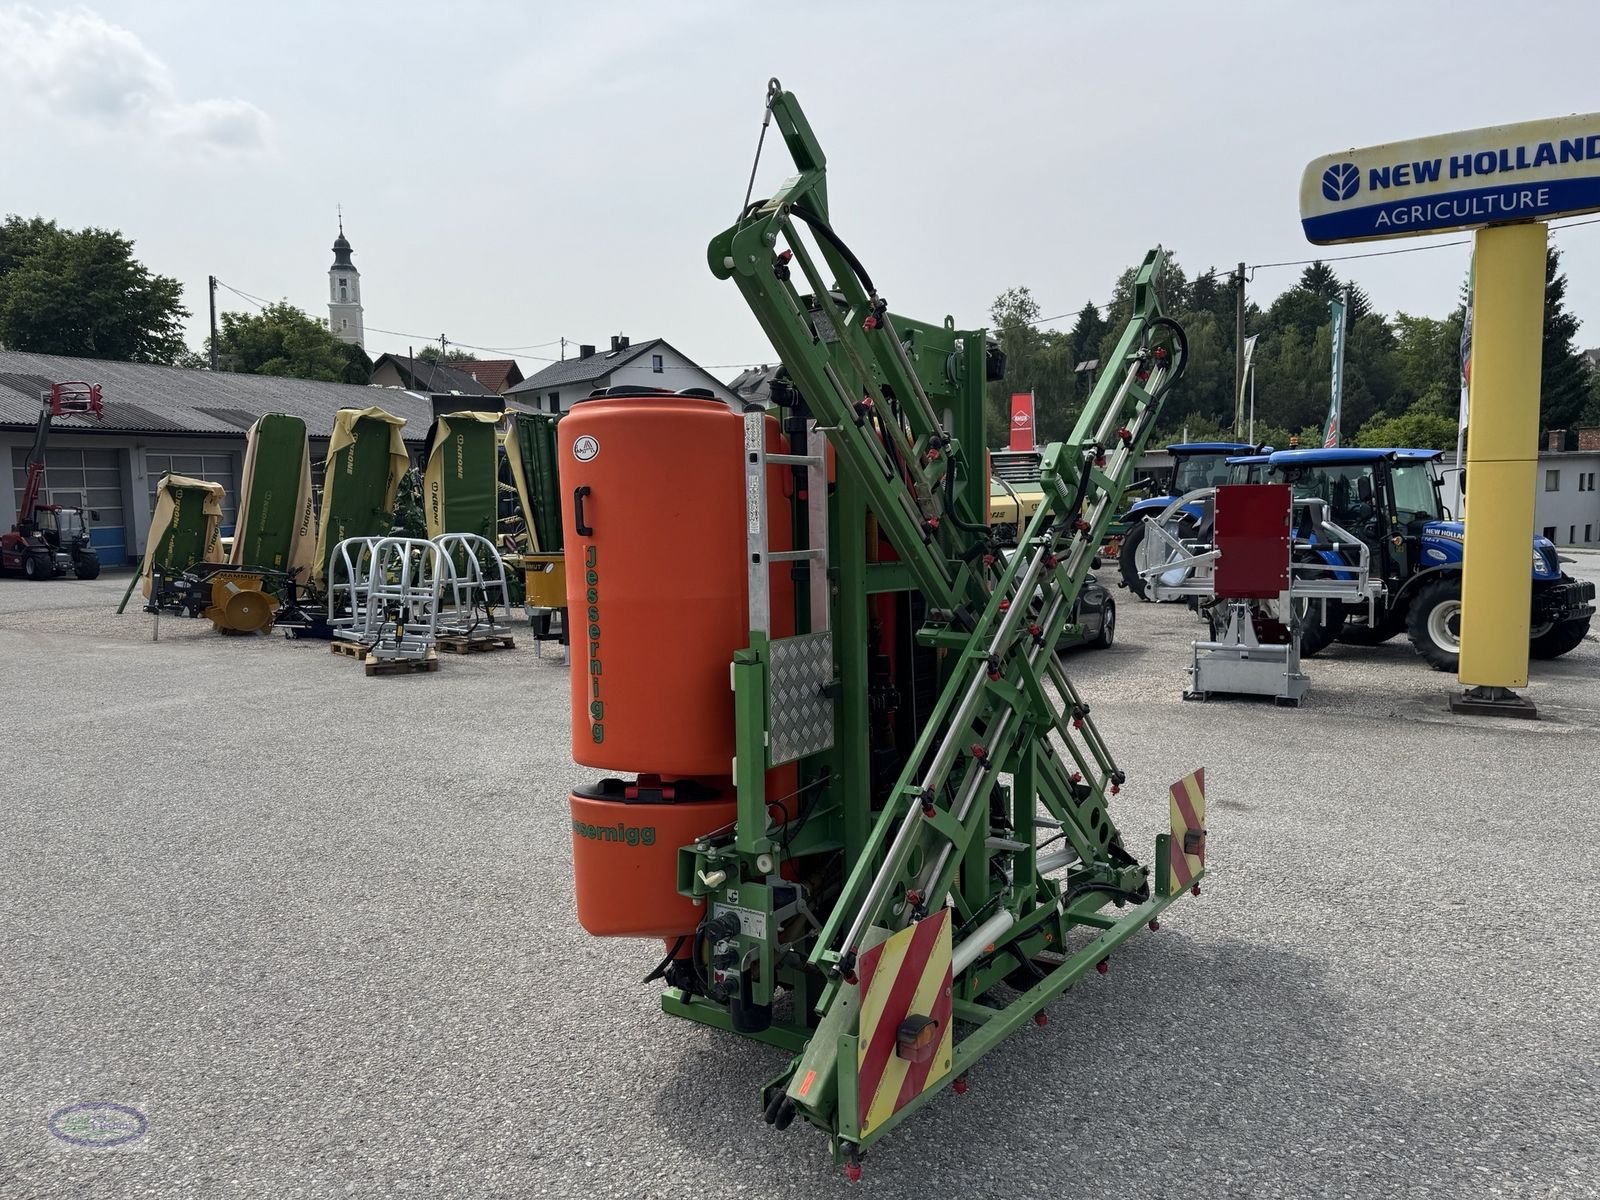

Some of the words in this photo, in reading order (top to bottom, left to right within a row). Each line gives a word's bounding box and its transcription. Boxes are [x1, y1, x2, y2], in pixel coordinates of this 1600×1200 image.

[1369, 158, 1442, 191] NEW
[1450, 134, 1600, 179] HOLLAND
[1375, 188, 1550, 228] AGRICULTURE
[303, 496, 313, 528] KRONE
[431, 491, 439, 526] KRONE
